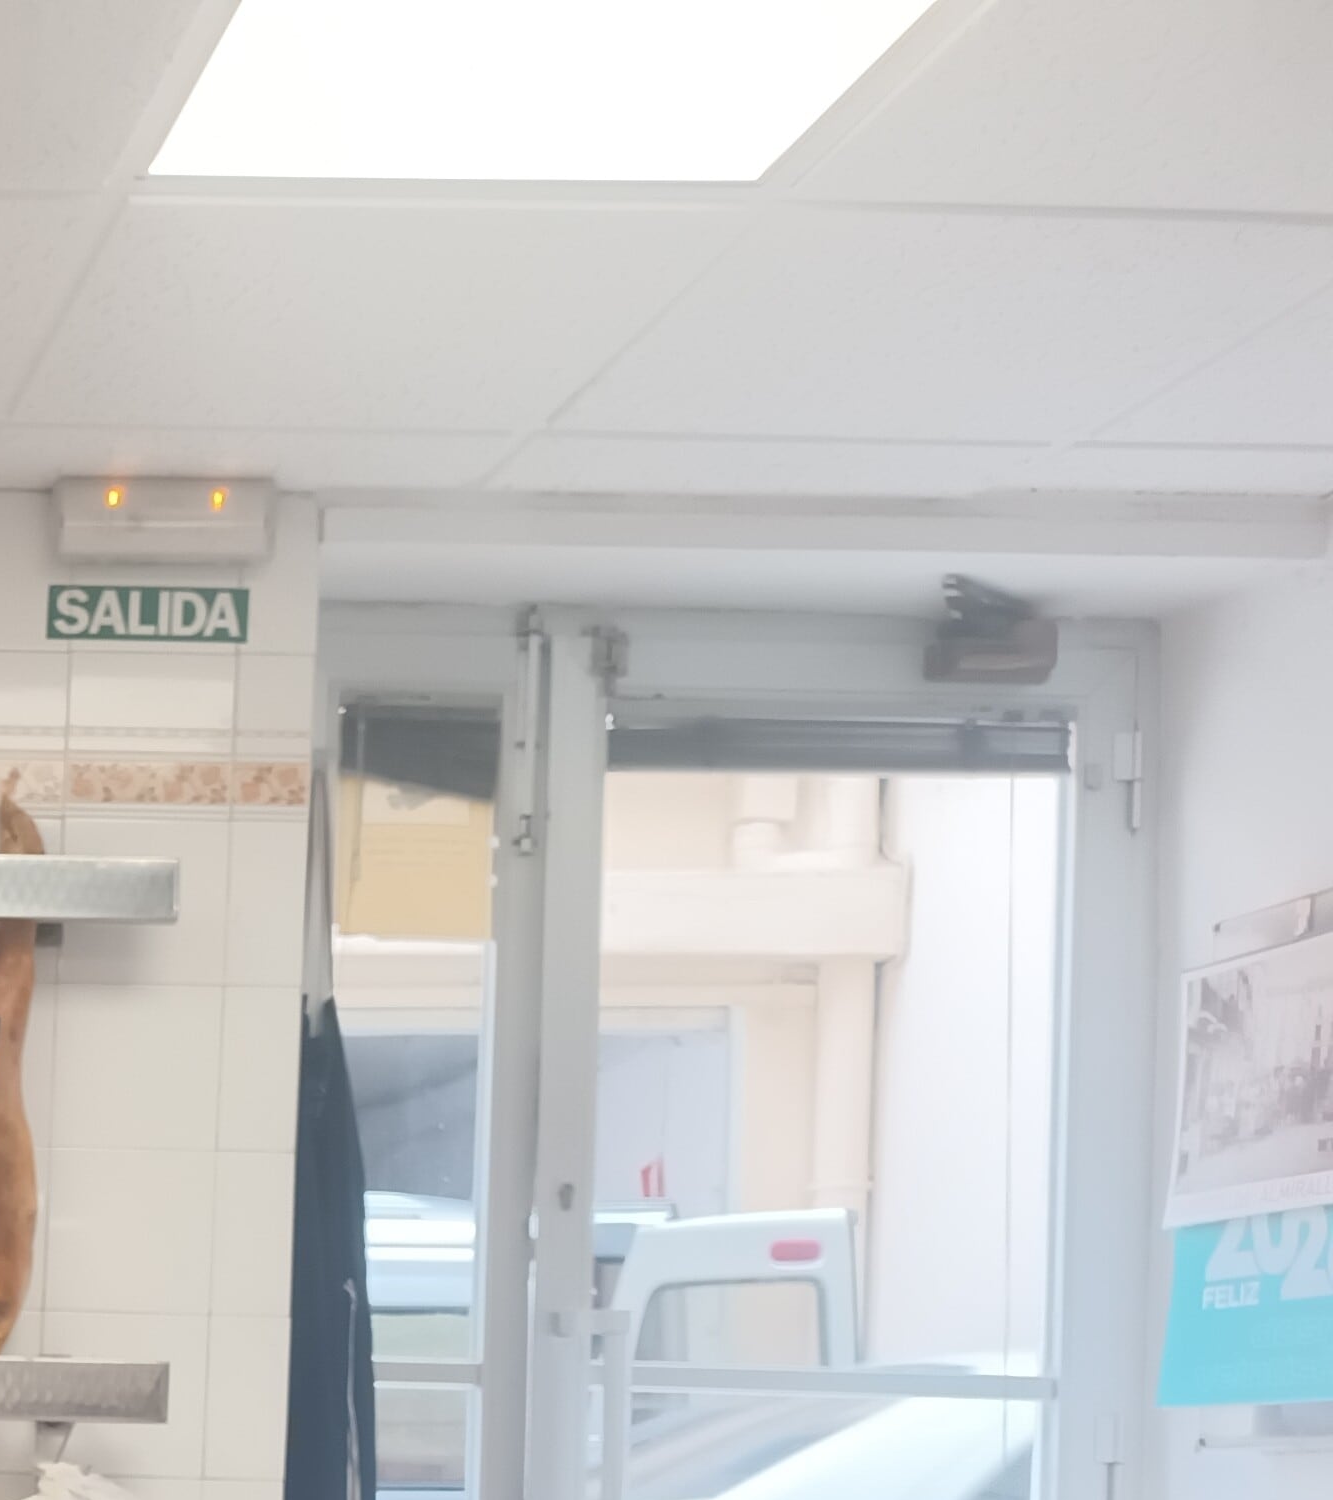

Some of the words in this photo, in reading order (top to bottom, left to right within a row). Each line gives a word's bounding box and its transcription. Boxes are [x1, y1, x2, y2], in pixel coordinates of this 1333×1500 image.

[53, 589, 242, 638] SALIDA
[1205, 1206, 1333, 1300] 202
[1202, 1281, 1261, 1310] FELIZ
